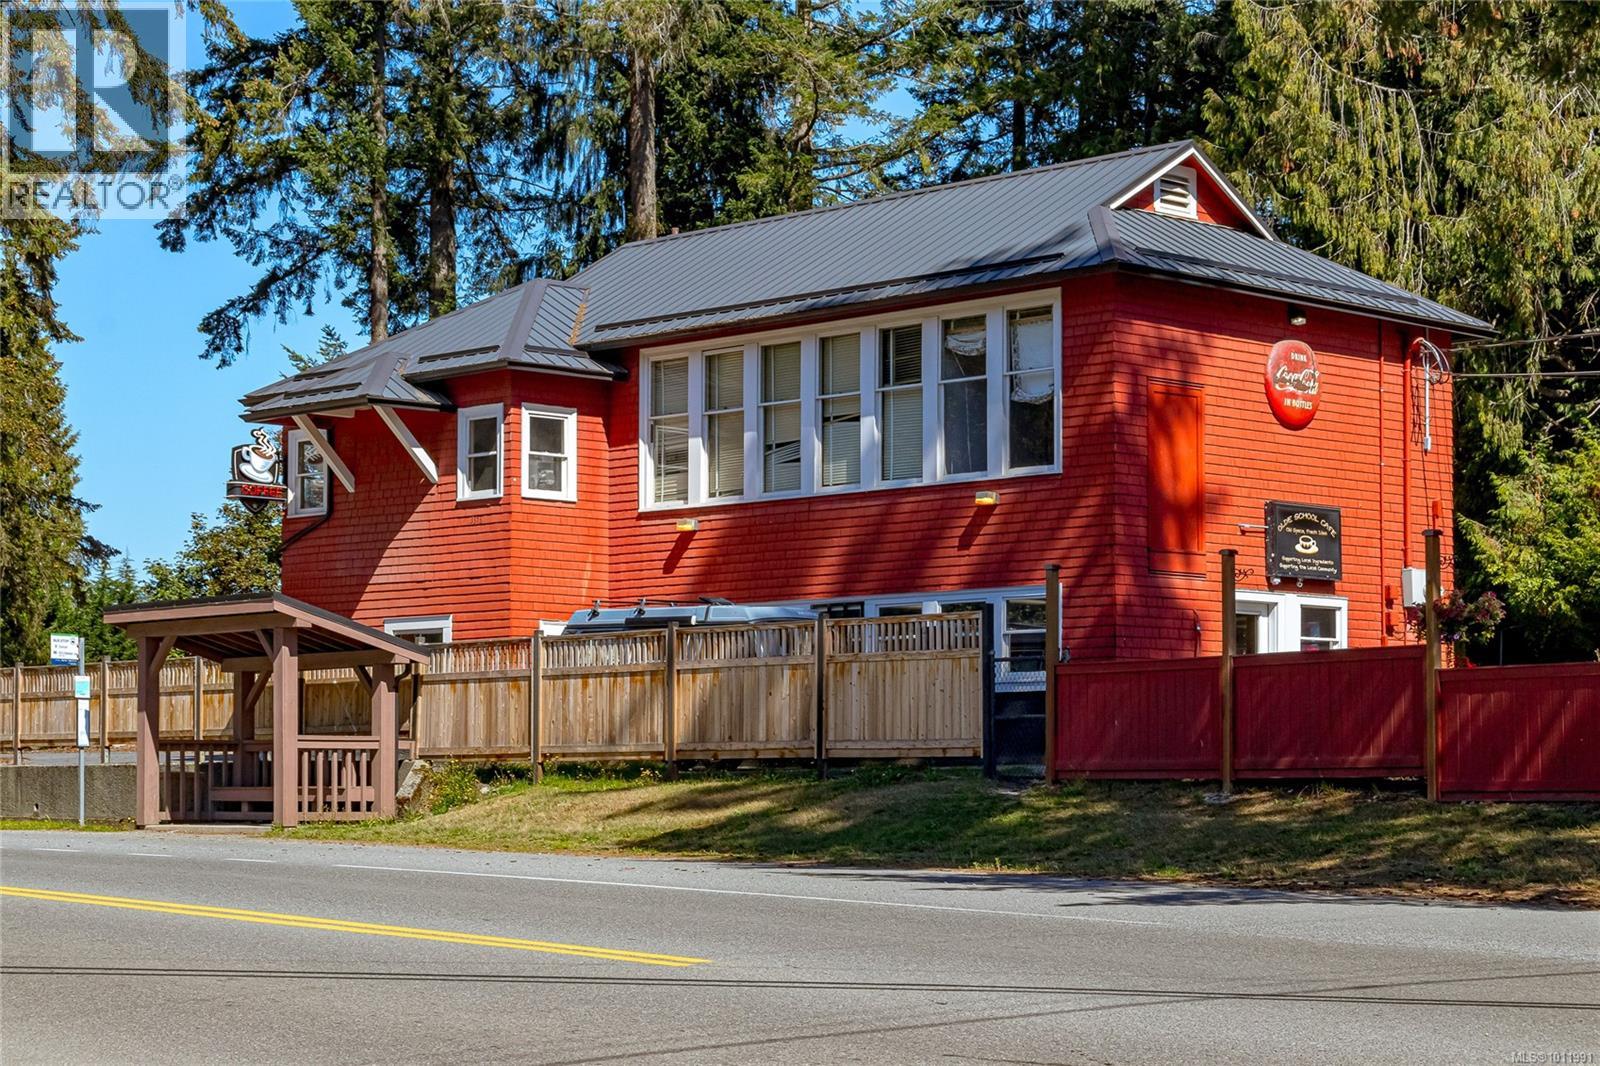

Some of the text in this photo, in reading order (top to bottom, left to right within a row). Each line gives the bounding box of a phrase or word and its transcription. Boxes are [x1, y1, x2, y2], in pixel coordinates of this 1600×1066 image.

[1283, 397, 1313, 410] IN BOTTLES
[1277, 512, 1337, 538] OLDE SCHOOL CAFE
